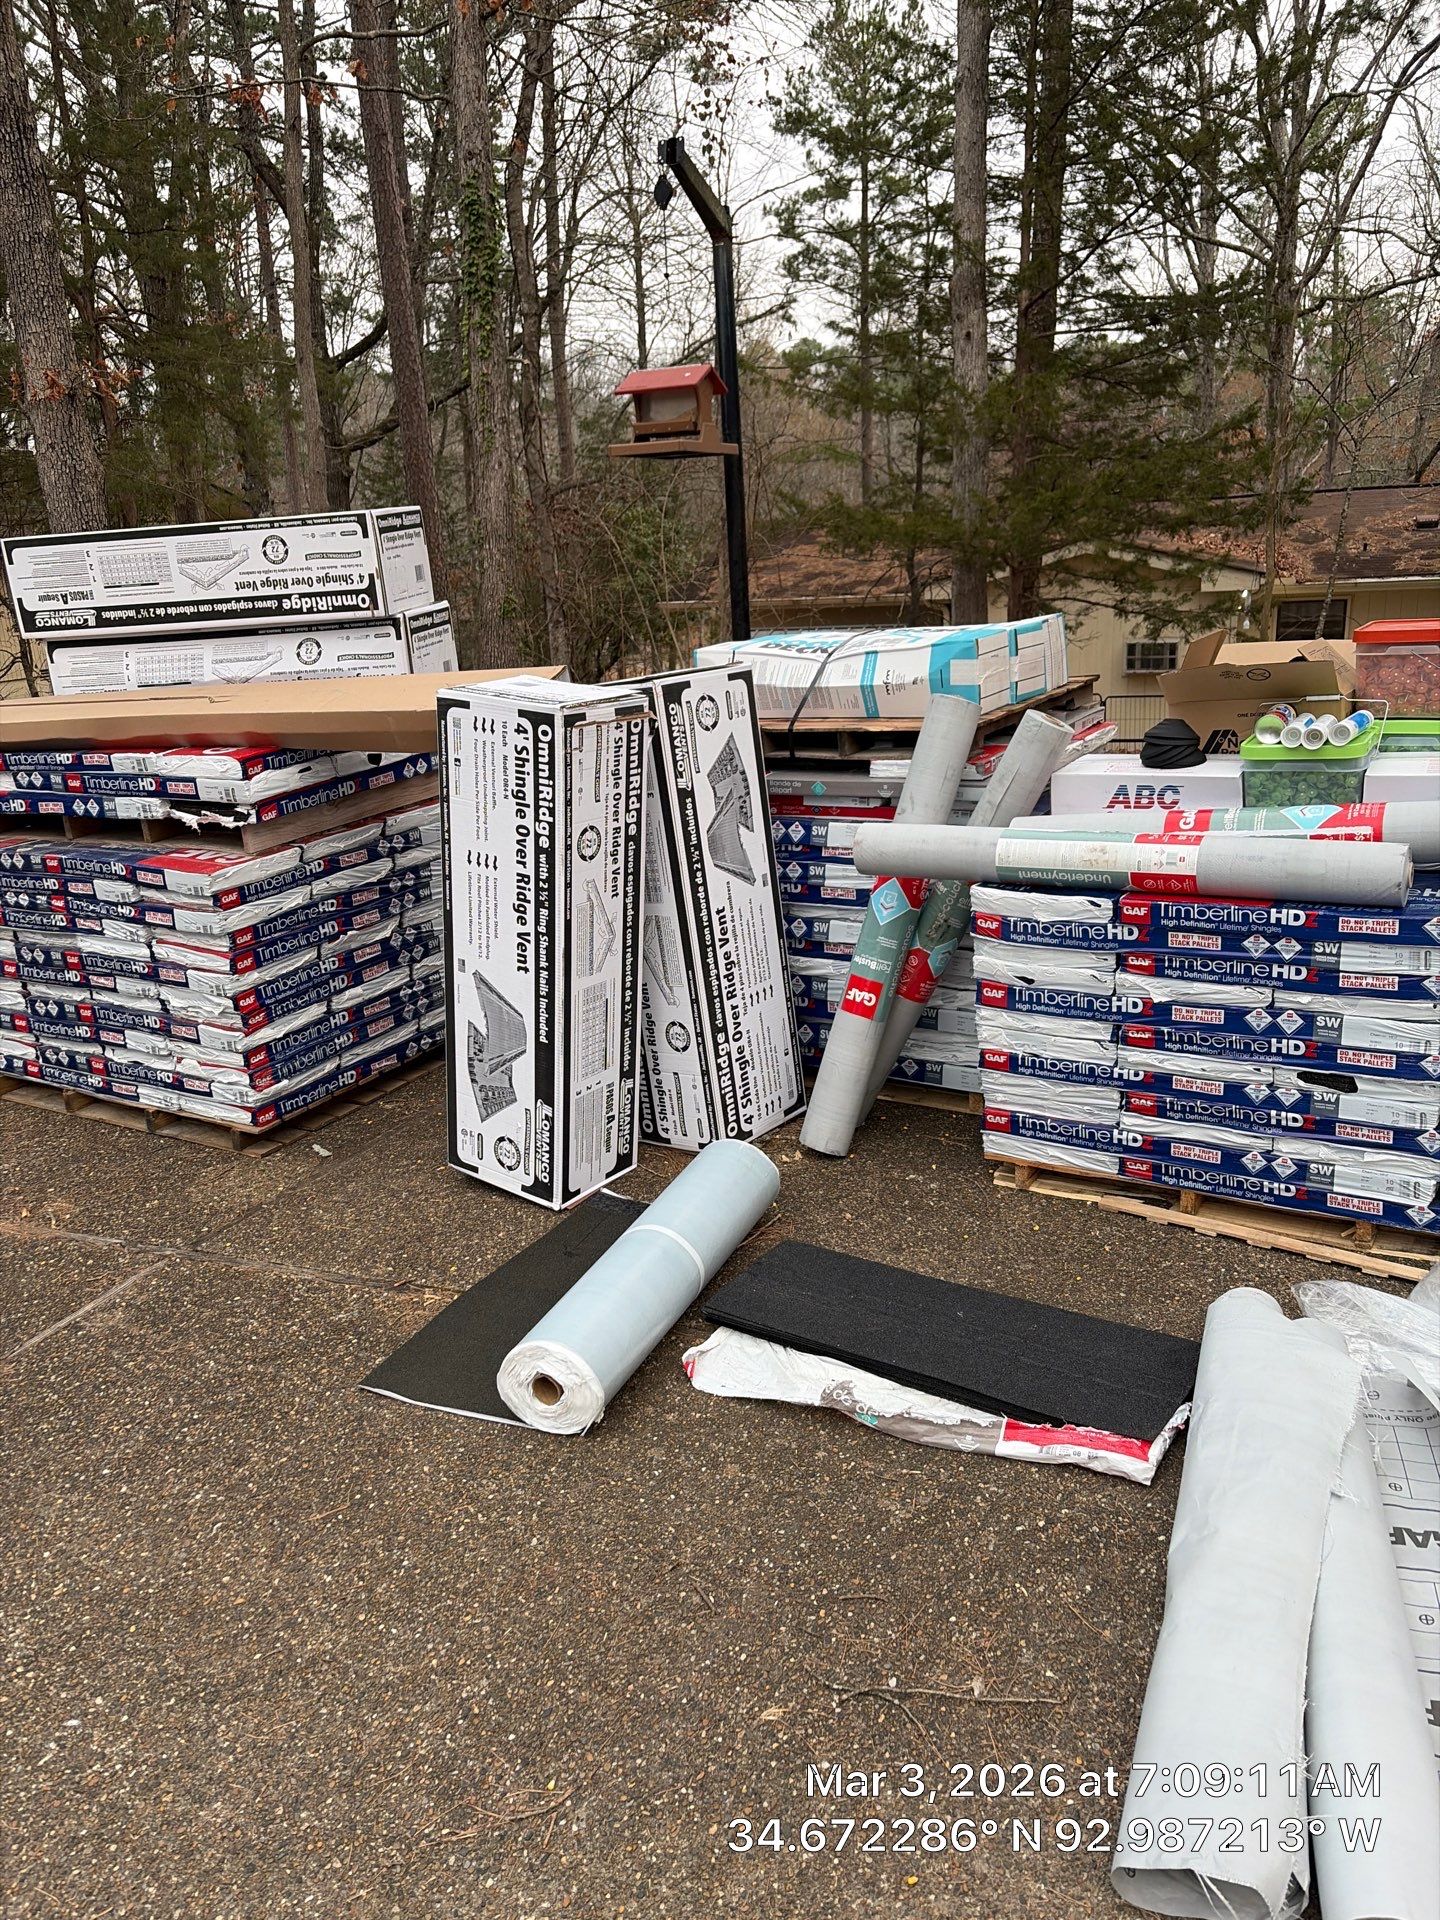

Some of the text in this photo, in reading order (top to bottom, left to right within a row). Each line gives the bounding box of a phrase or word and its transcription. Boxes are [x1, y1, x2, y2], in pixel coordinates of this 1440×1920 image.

[235, 573, 364, 591] 4' Shingle Over Ridge Vent
[60, 593, 68, 604] A
[69, 590, 89, 601] PASOS
[214, 601, 252, 613] espigados
[255, 600, 277, 609] clavos
[282, 593, 370, 612] OmniRidge
[102, 609, 136, 620] incluidos
[149, 608, 154, 616] 2
[156, 607, 165, 615] de
[167, 604, 197, 615] reborde
[35, 615, 95, 626] LOMANCO
[502, 721, 508, 730] 10
[668, 703, 689, 788] LOMANCO VENTS
[248, 764, 263, 775] GAF
[51, 774, 62, 784] SW
[68, 779, 81, 787] GAF
[626, 720, 641, 836] OmniRidge
[535, 724, 553, 848] OmniRidge
[1105, 784, 1184, 809] ABC
[262, 810, 277, 821] GAF
[610, 723, 623, 899] 4' Shingle Over Ridge Vent
[685, 797, 698, 845] incluidos
[812, 826, 827, 836] SW
[511, 723, 531, 974] 4' Shingle Over Ridge Vent
[627, 841, 635, 873] clavos
[538, 854, 548, 879] with
[692, 862, 701, 870] 2
[694, 871, 703, 884] de
[1018, 870, 1112, 884] Underlayment
[625, 875, 635, 927] espigados
[696, 886, 710, 926] reborde
[1123, 906, 1148, 916] GAF
[536, 908, 548, 934] Ring
[813, 922, 828, 932] SW
[977, 920, 1000, 930] GAF
[1161, 919, 1179, 928] High
[1251, 924, 1282, 933] Shingles
[701, 927, 712, 945] con
[1365, 926, 1396, 934] PALLETS
[538, 935, 549, 969] Shank
[1314, 941, 1340, 954] SW
[624, 948, 632, 987] reborde
[1128, 957, 1152, 965] GAF
[705, 946, 721, 996] espigados
[538, 971, 548, 996] Nails
[624, 989, 632, 1002] de
[846, 988, 876, 1006] GAF
[983, 987, 1005, 997] GAF
[624, 1003, 632, 1011] 2
[712, 998, 724, 1027] clavos
[538, 998, 548, 1043] Included
[715, 906, 754, 1125] 4' Shingle Over Ridge Vent
[1316, 1017, 1342, 1028] SW
[622, 1027, 631, 1072] incluidos
[985, 1053, 1008, 1063] GAF
[926, 1063, 941, 1072] SW
[717, 1032, 738, 1137] OmniRidge
[1314, 1092, 1337, 1102] SW
[259, 1110, 275, 1123] GAF
[622, 1084, 633, 1153] LOMANCO
[986, 1114, 1008, 1124] GAF
[540, 1107, 552, 1183] LOMANCO
[504, 1148, 511, 1159] 72
[1126, 1161, 1149, 1171] GAF
[1310, 1164, 1333, 1175] SW
[1394, 1415, 1424, 1423] ONLY
